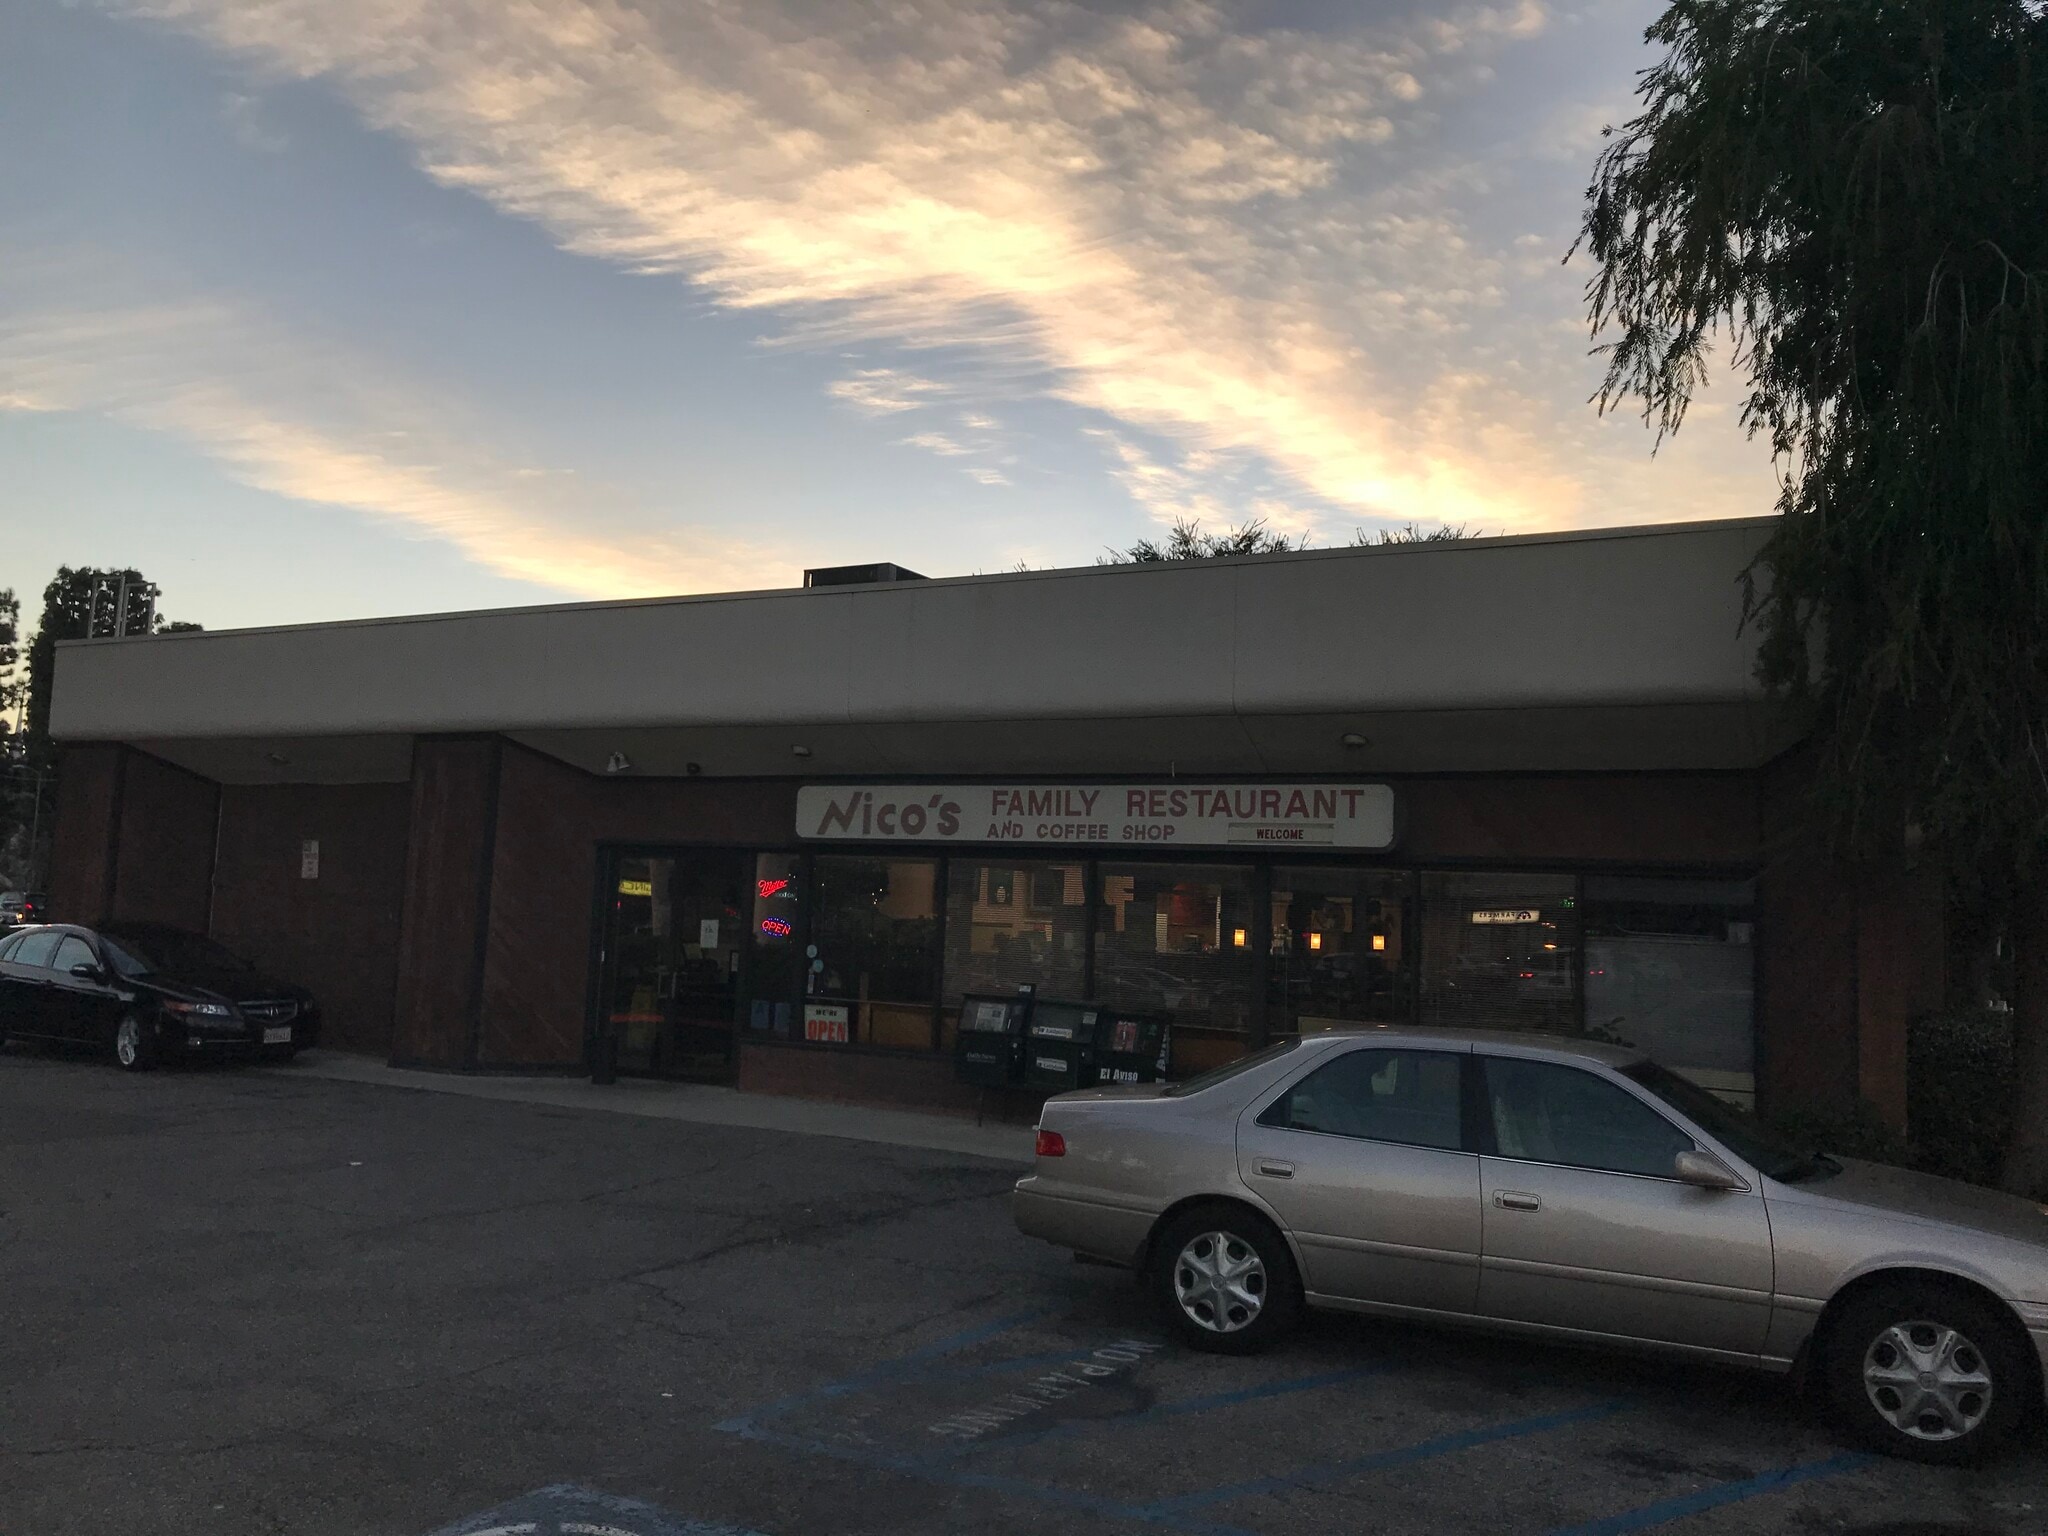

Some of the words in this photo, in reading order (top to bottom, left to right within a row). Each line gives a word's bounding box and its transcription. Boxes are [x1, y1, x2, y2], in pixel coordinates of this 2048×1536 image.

[816, 791, 962, 836] Nico's
[991, 789, 1100, 817] FAMILY
[1126, 789, 1365, 819] RESTAURANT
[987, 819, 1024, 839] AND
[1036, 823, 1109, 840] COFFEE
[1122, 823, 1175, 841] SHOP
[1256, 828, 1305, 840] WELCOME
[758, 879, 789, 898] Miller
[761, 919, 792, 936] OPEN
[807, 1019, 847, 1041] OPEN
[1099, 1067, 1111, 1080] El
[1091, 1339, 1164, 1361] NO
